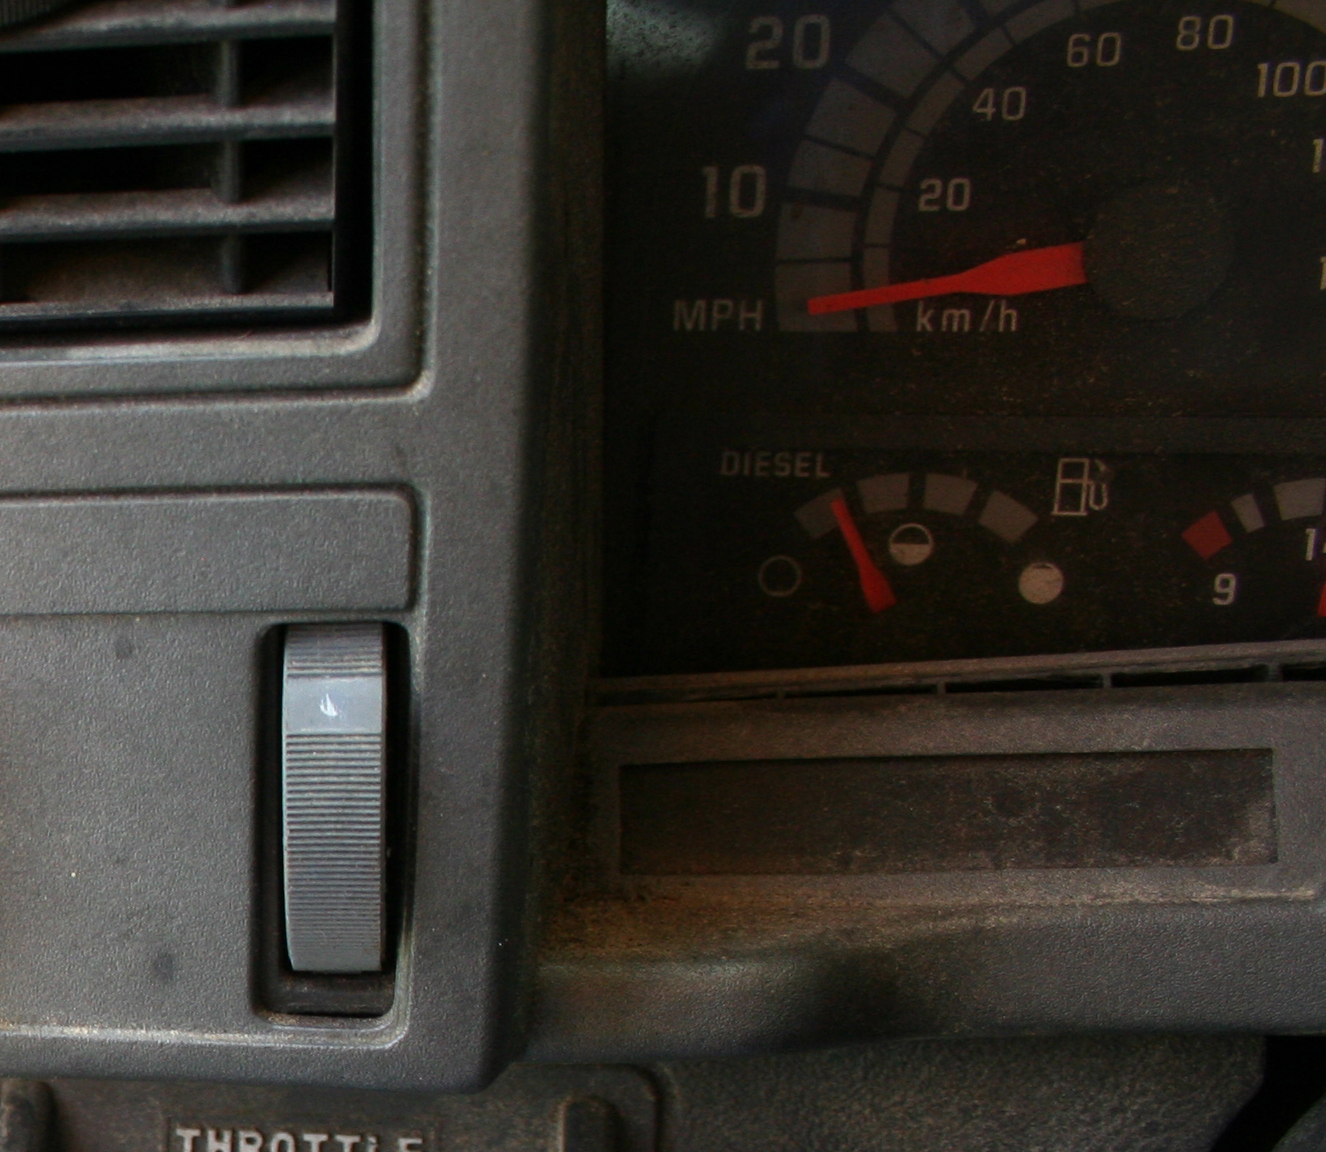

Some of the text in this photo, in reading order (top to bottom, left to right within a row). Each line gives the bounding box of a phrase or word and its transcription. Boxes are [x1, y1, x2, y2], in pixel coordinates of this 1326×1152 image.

[745, 14, 831, 70] 20
[1066, 31, 1123, 68] 60
[1176, 14, 1234, 50] 80
[1257, 60, 1326, 98] 100
[973, 86, 1027, 122] 40
[702, 164, 767, 219] 10
[918, 177, 972, 213] 20
[674, 299, 763, 332] MPH
[915, 299, 1019, 334] km/h
[720, 450, 831, 479] DIESEL
[1212, 572, 1237, 606] 9
